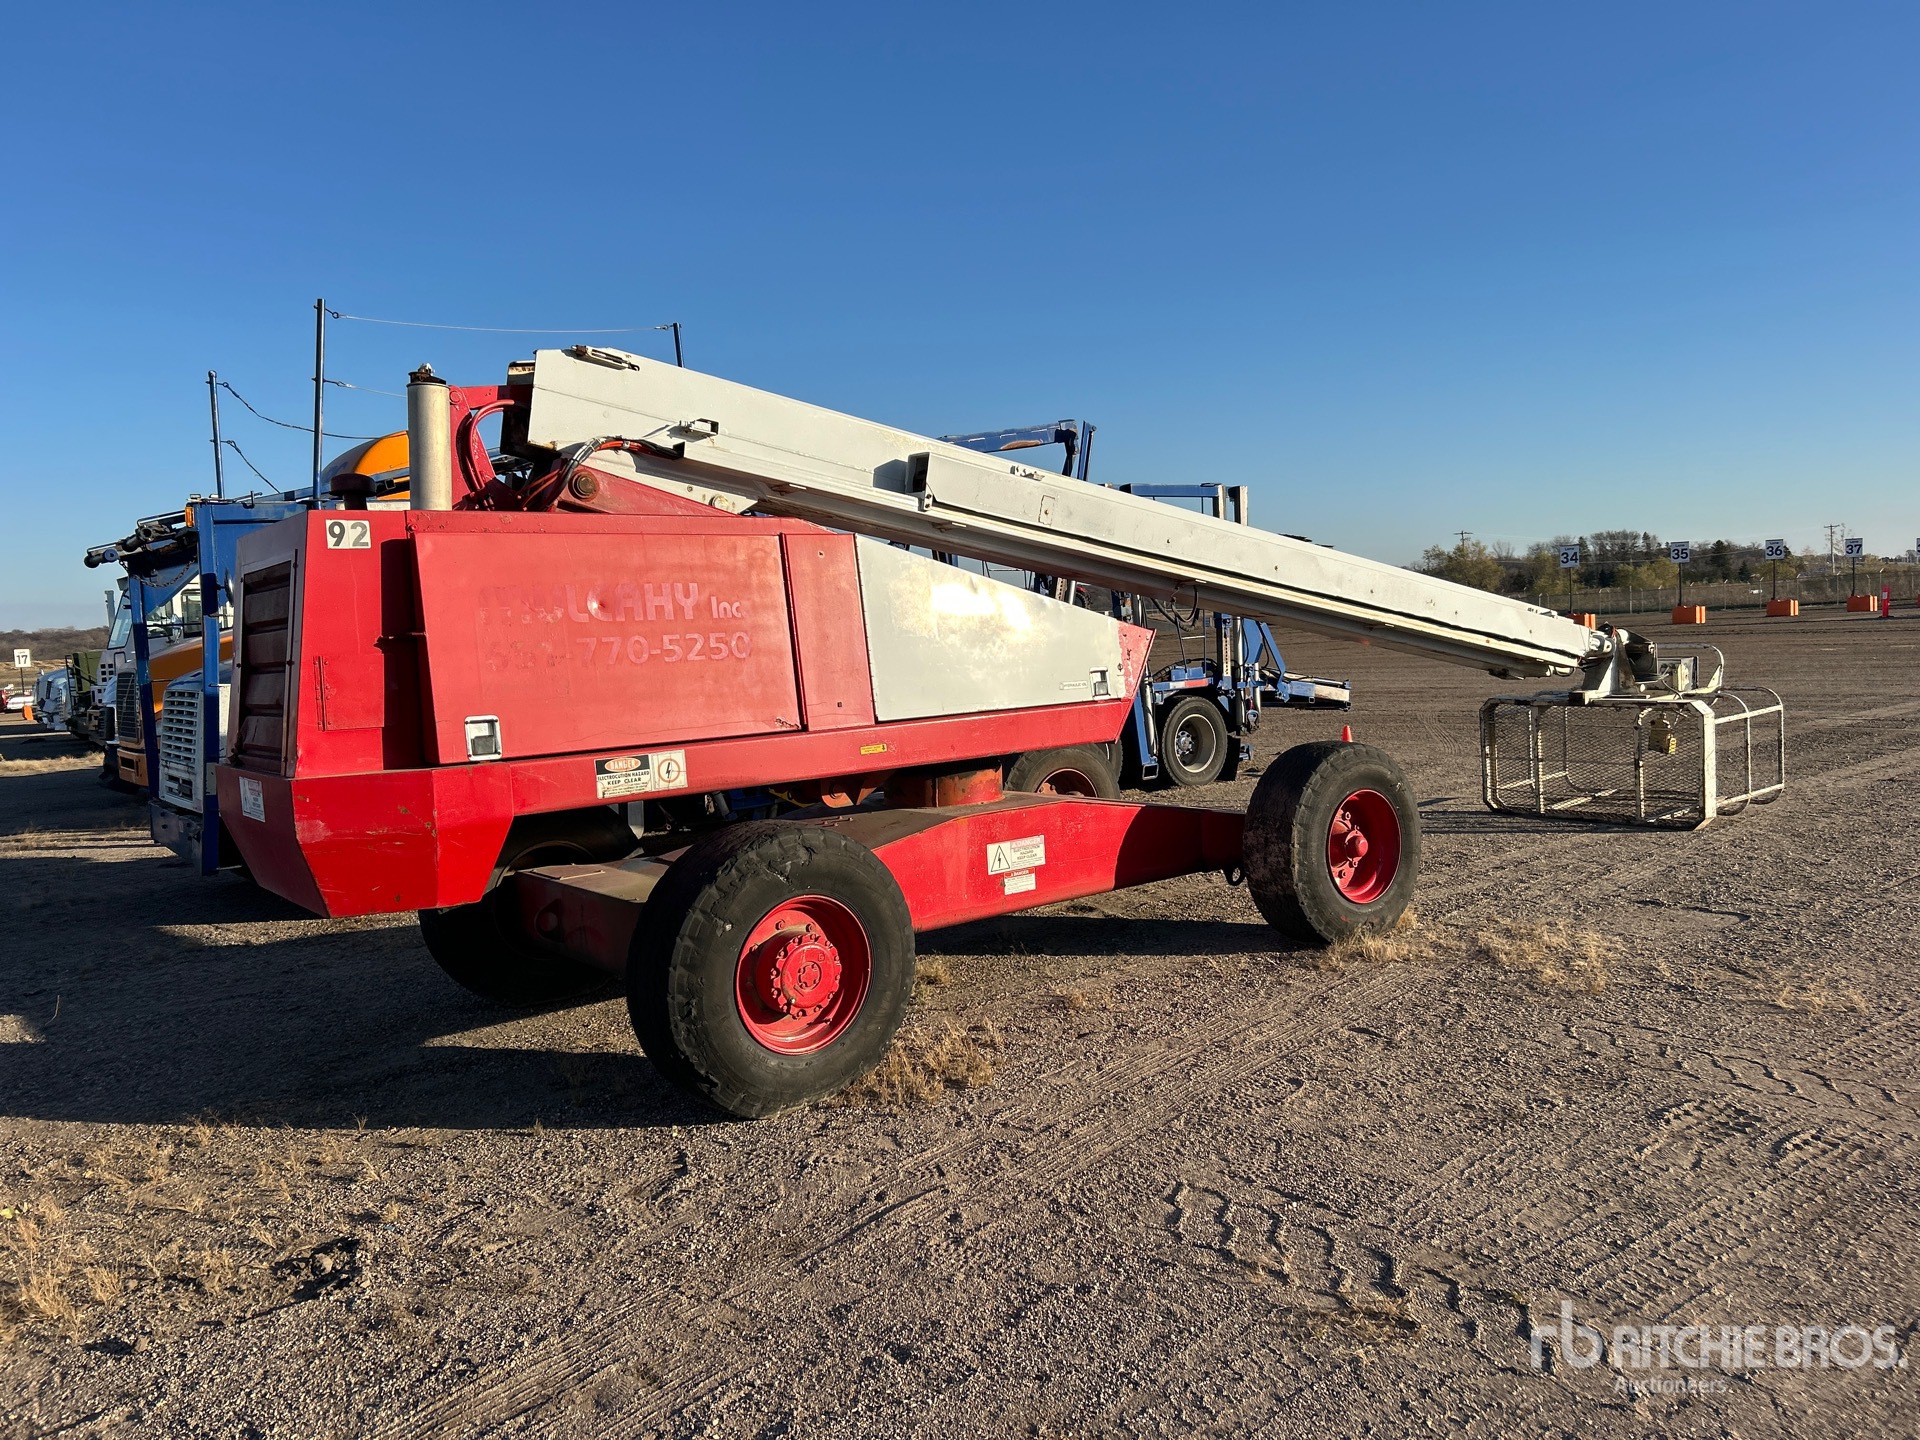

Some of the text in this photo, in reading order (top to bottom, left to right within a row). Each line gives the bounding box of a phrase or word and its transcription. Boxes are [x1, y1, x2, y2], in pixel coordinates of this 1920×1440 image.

[328, 521, 369, 547] 92
[1672, 548, 1688, 560] 35
[1766, 545, 1782, 556] 36
[1846, 544, 1862, 554] 37
[1561, 551, 1578, 564] 34
[16, 655, 28, 665] 17
[610, 759, 636, 769] DANGER
